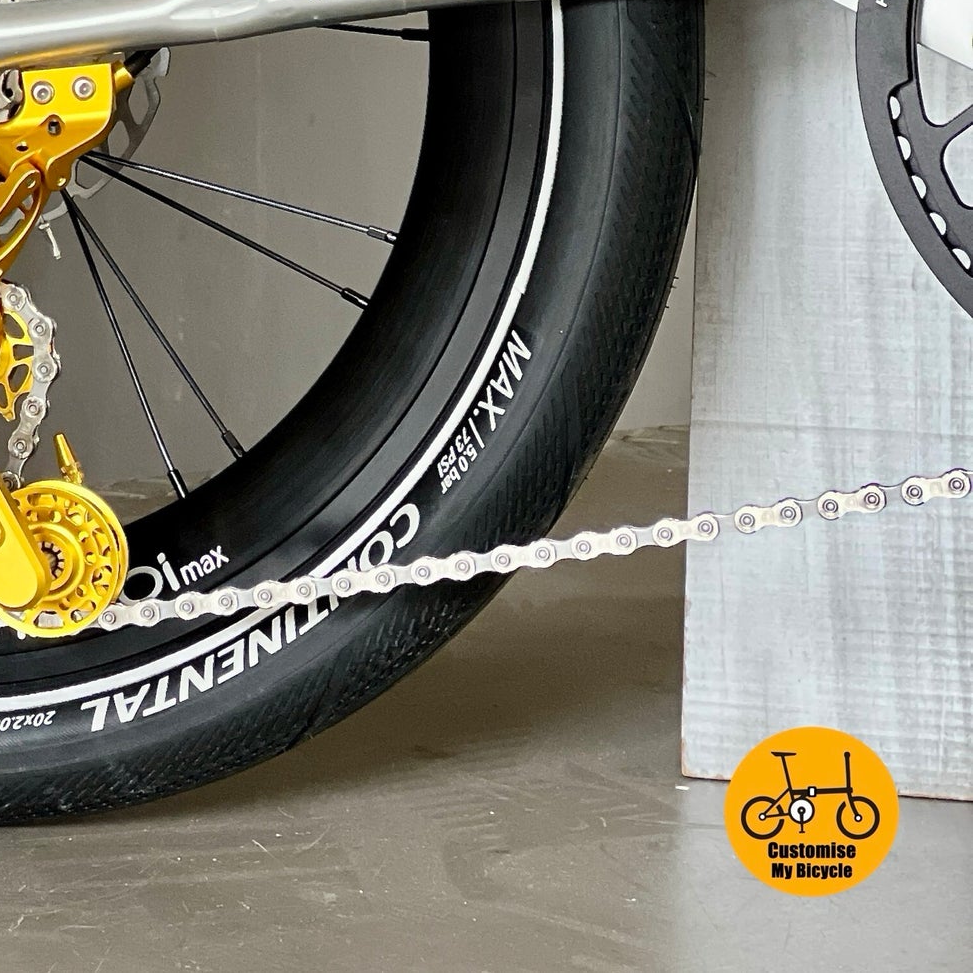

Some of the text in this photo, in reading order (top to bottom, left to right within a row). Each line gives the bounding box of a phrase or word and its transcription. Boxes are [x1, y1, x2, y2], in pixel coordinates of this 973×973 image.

[437, 426, 471, 478] 73 PSI
[440, 443, 477, 495] 5.0 bar
[180, 545, 229, 586] max
